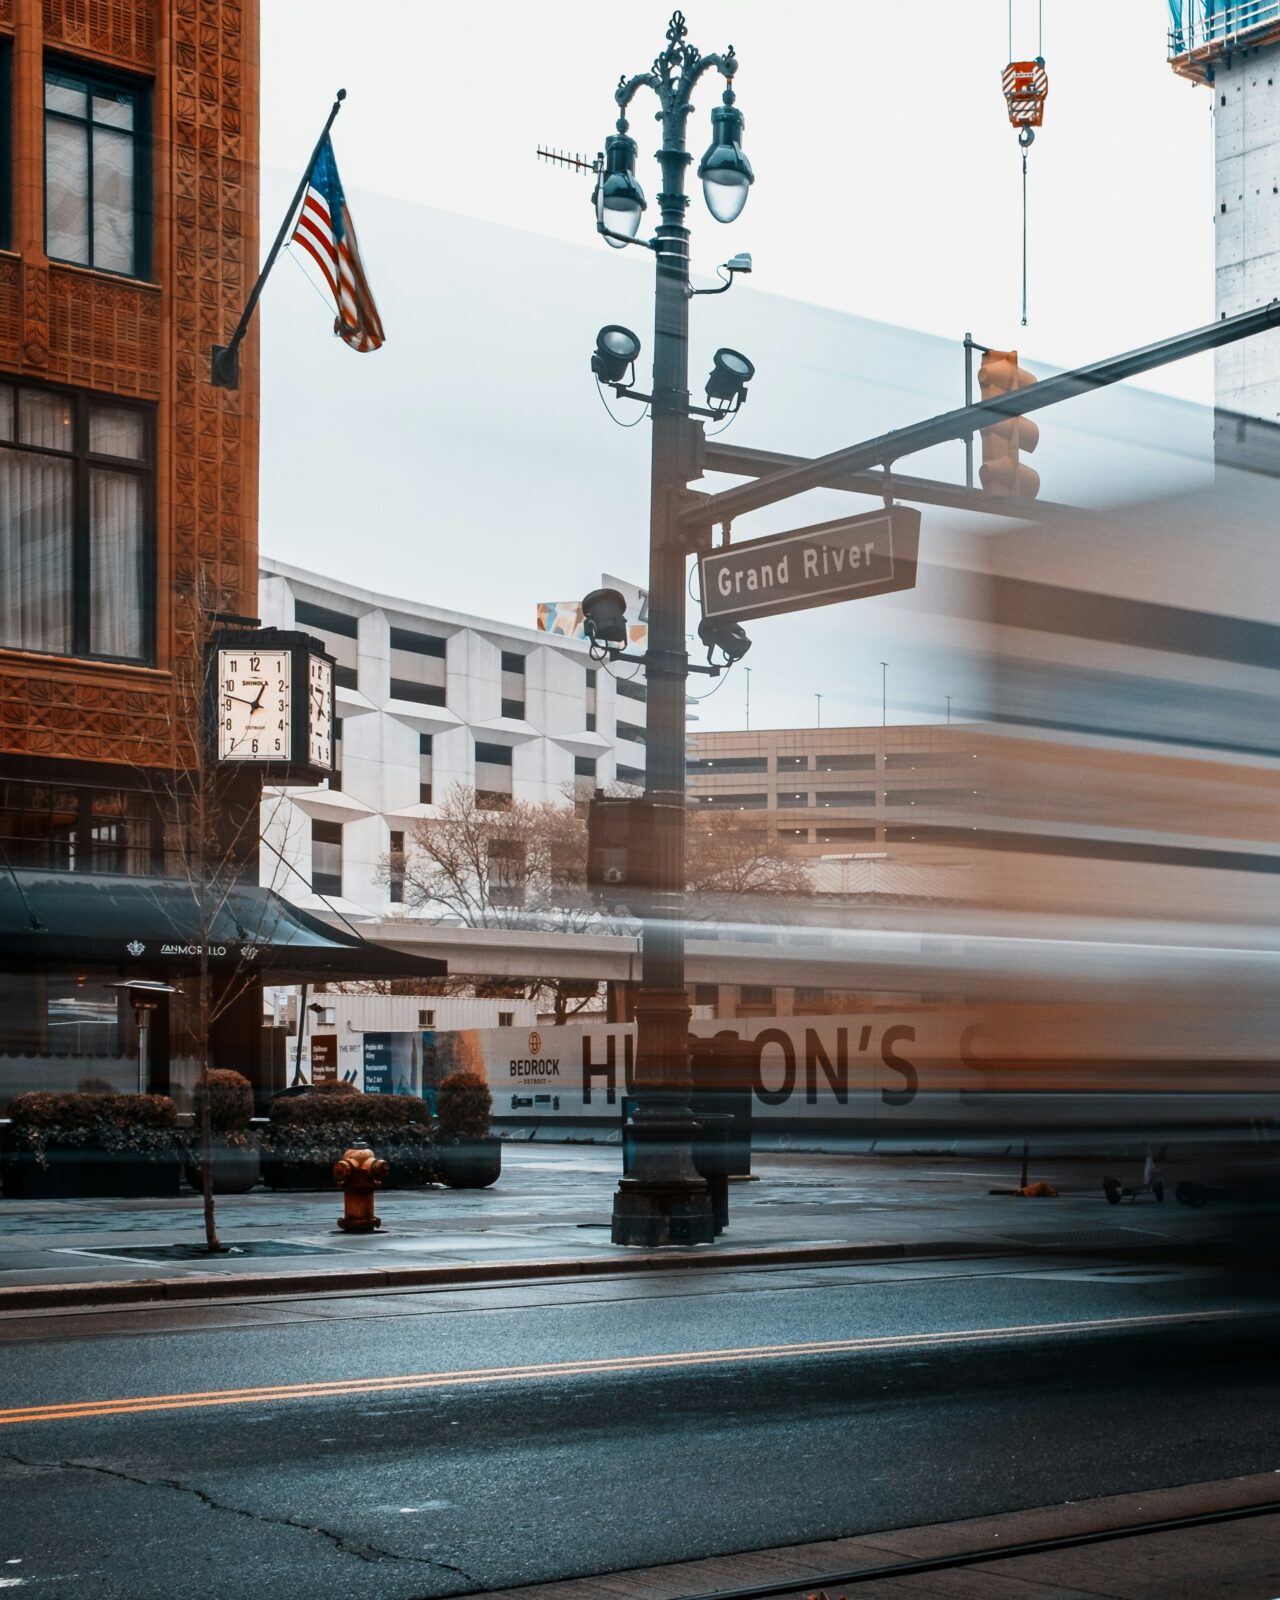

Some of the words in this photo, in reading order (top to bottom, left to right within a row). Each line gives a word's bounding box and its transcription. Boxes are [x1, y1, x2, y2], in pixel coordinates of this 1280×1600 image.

[718, 554, 789, 597] Grand
[803, 541, 875, 579] River
[230, 661, 237, 672] 11
[249, 657, 260, 672] 12
[276, 661, 281, 673] 1
[225, 680, 234, 692] 10
[278, 680, 284, 692] 2
[226, 699, 232, 711] 9
[278, 699, 284, 712] 3
[226, 719, 232, 731] 8
[278, 719, 284, 732] 4
[230, 738, 236, 751] 7
[251, 738, 258, 753] 6
[274, 738, 281, 751] 5
[160, 944, 227, 956] SANMORLLO
[510, 1059, 560, 1076] BEDROCK
[582, 1025, 919, 1106] HON'S
